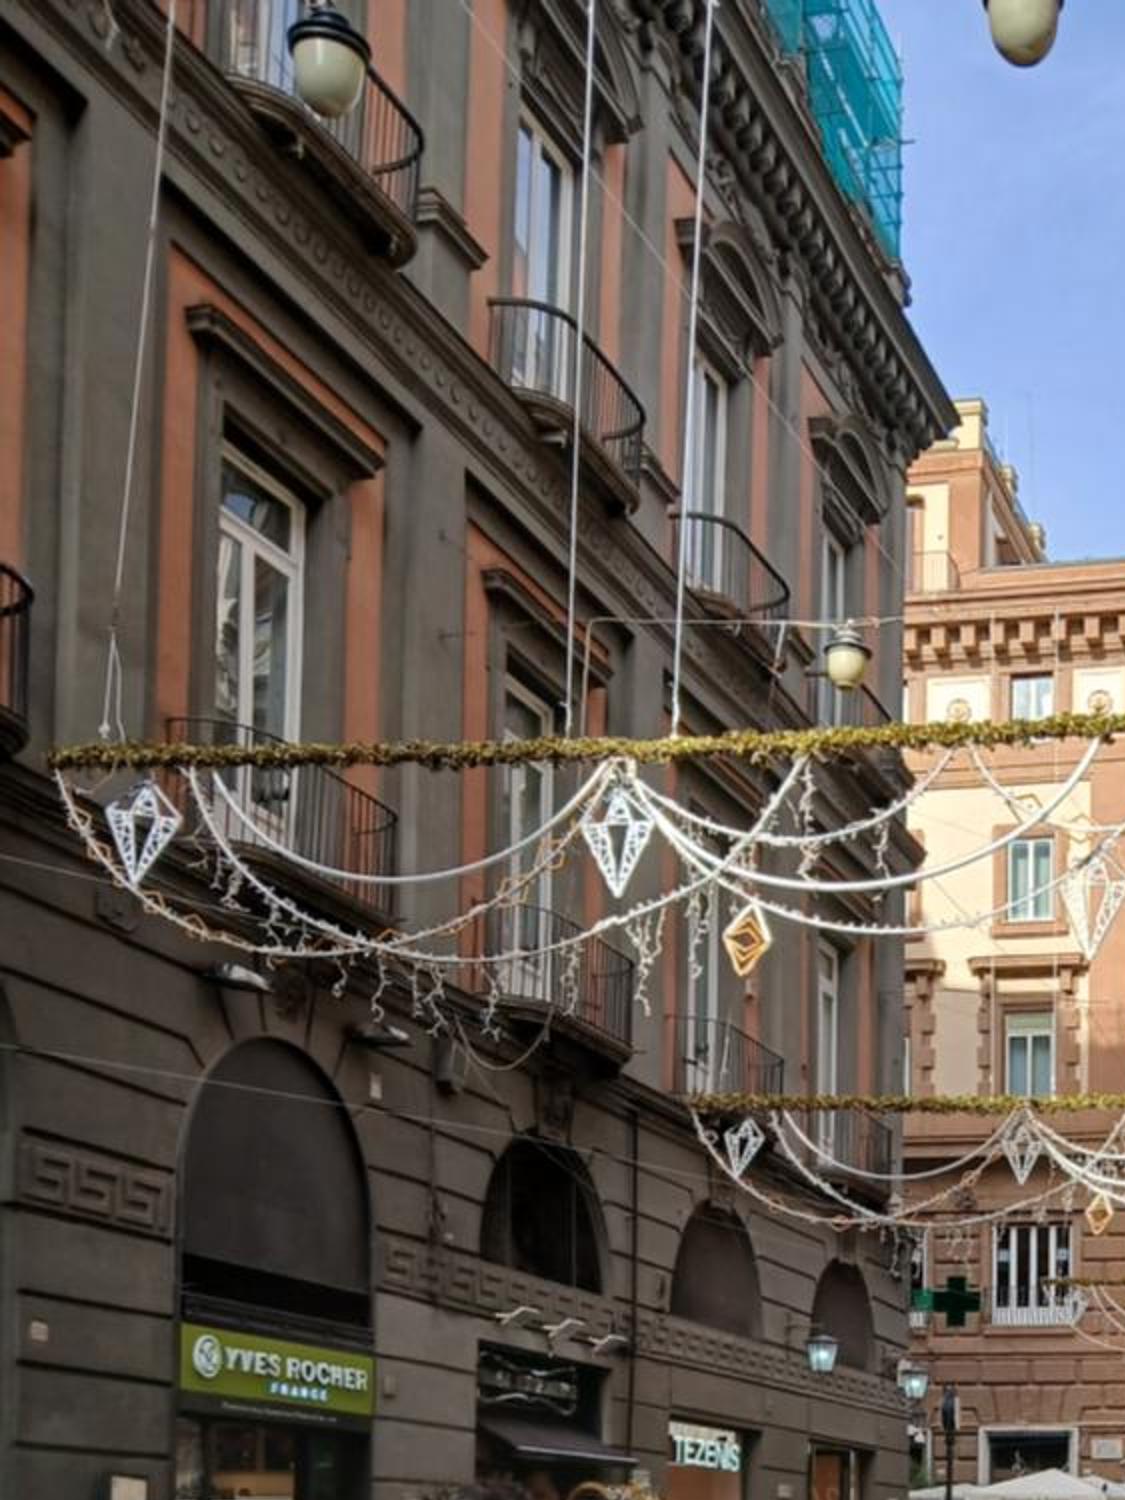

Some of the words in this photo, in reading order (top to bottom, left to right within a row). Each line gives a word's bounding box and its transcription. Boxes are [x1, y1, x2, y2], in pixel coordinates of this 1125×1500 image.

[224, 1346, 282, 1377] YVES
[286, 1356, 369, 1391] ROCHER
[269, 1381, 329, 1401] FRANCE
[673, 1438, 741, 1473] TEZENIS
